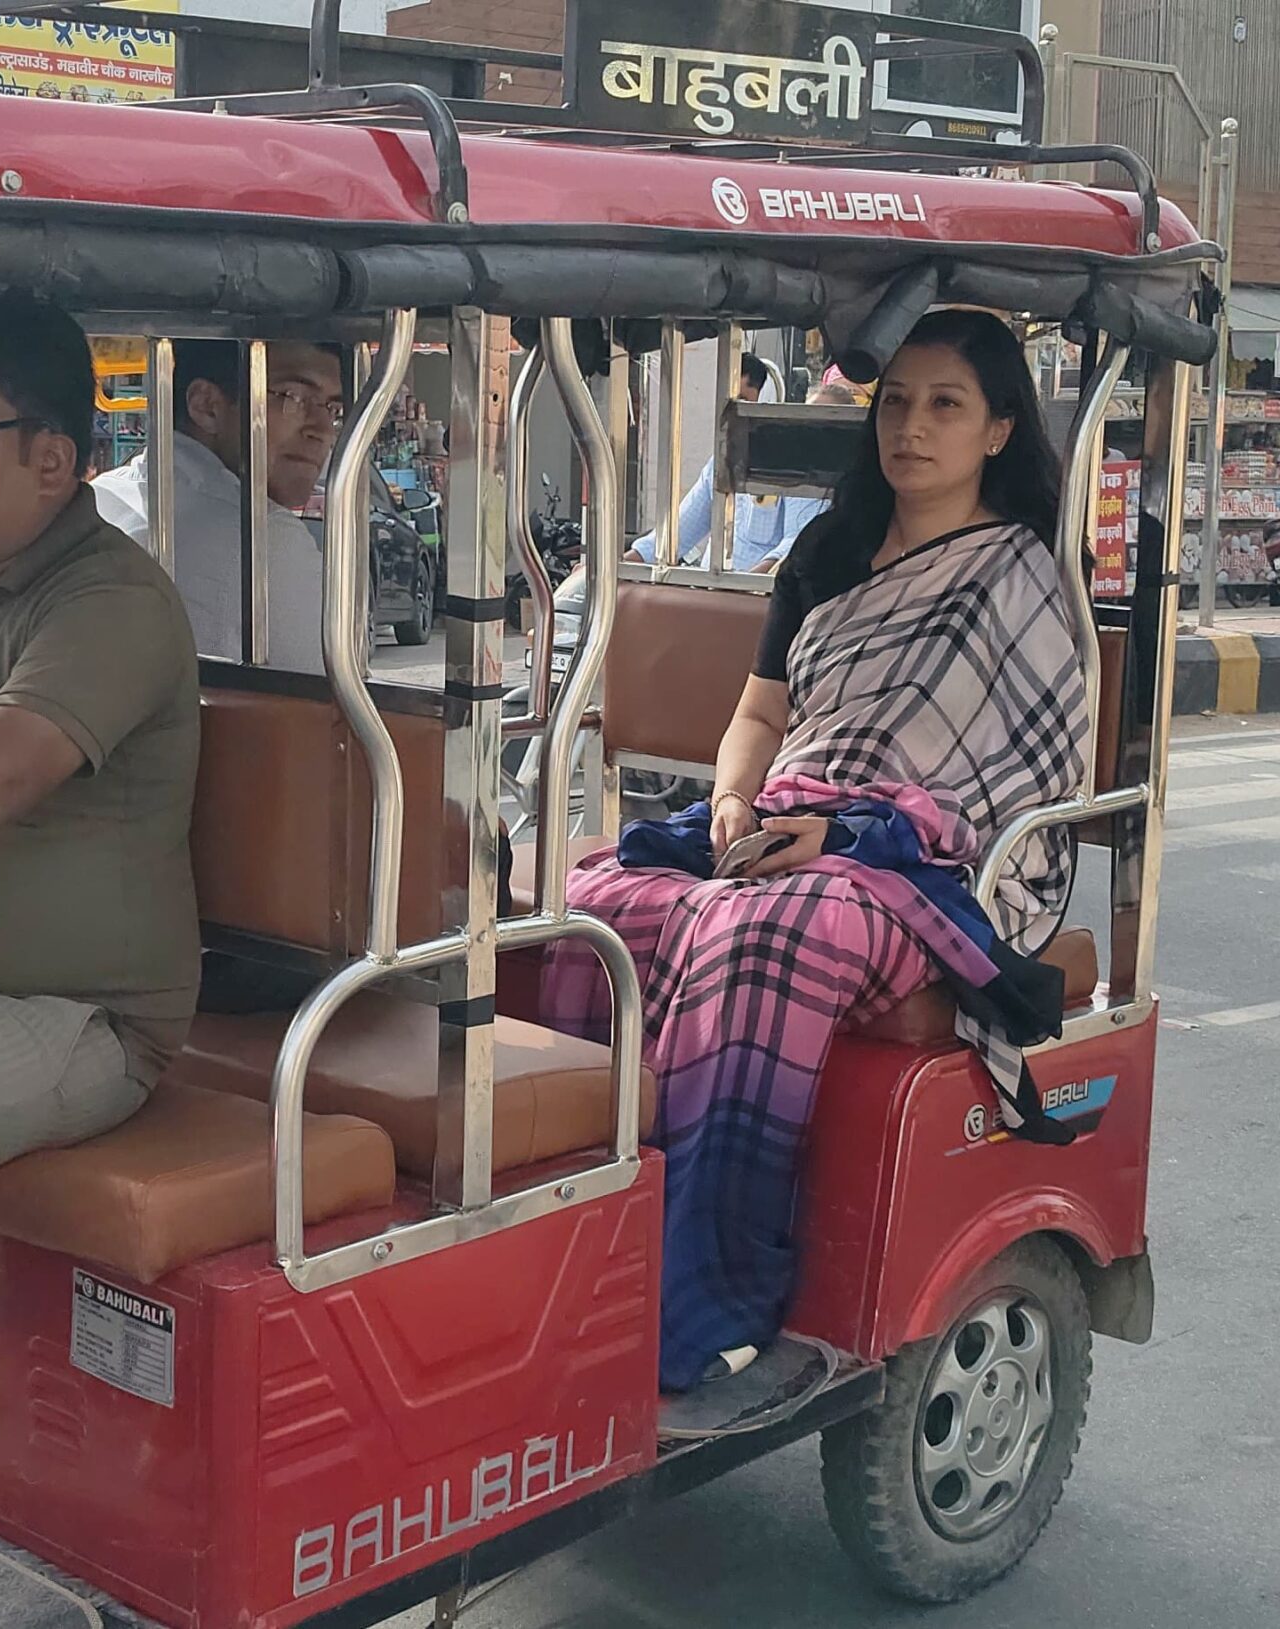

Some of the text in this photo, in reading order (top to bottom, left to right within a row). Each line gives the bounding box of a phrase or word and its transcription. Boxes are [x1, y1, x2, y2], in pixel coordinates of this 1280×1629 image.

[57, 57, 100, 76] महावीर
[101, 61, 125, 79] चौक
[129, 67, 173, 86] नारनौल
[600, 35, 867, 135] बाहुबली
[758, 188, 927, 222] BAHUBALI
[96, 1285, 165, 1326] BAHUBALI
[292, 1416, 615, 1599] BAHUBALI
